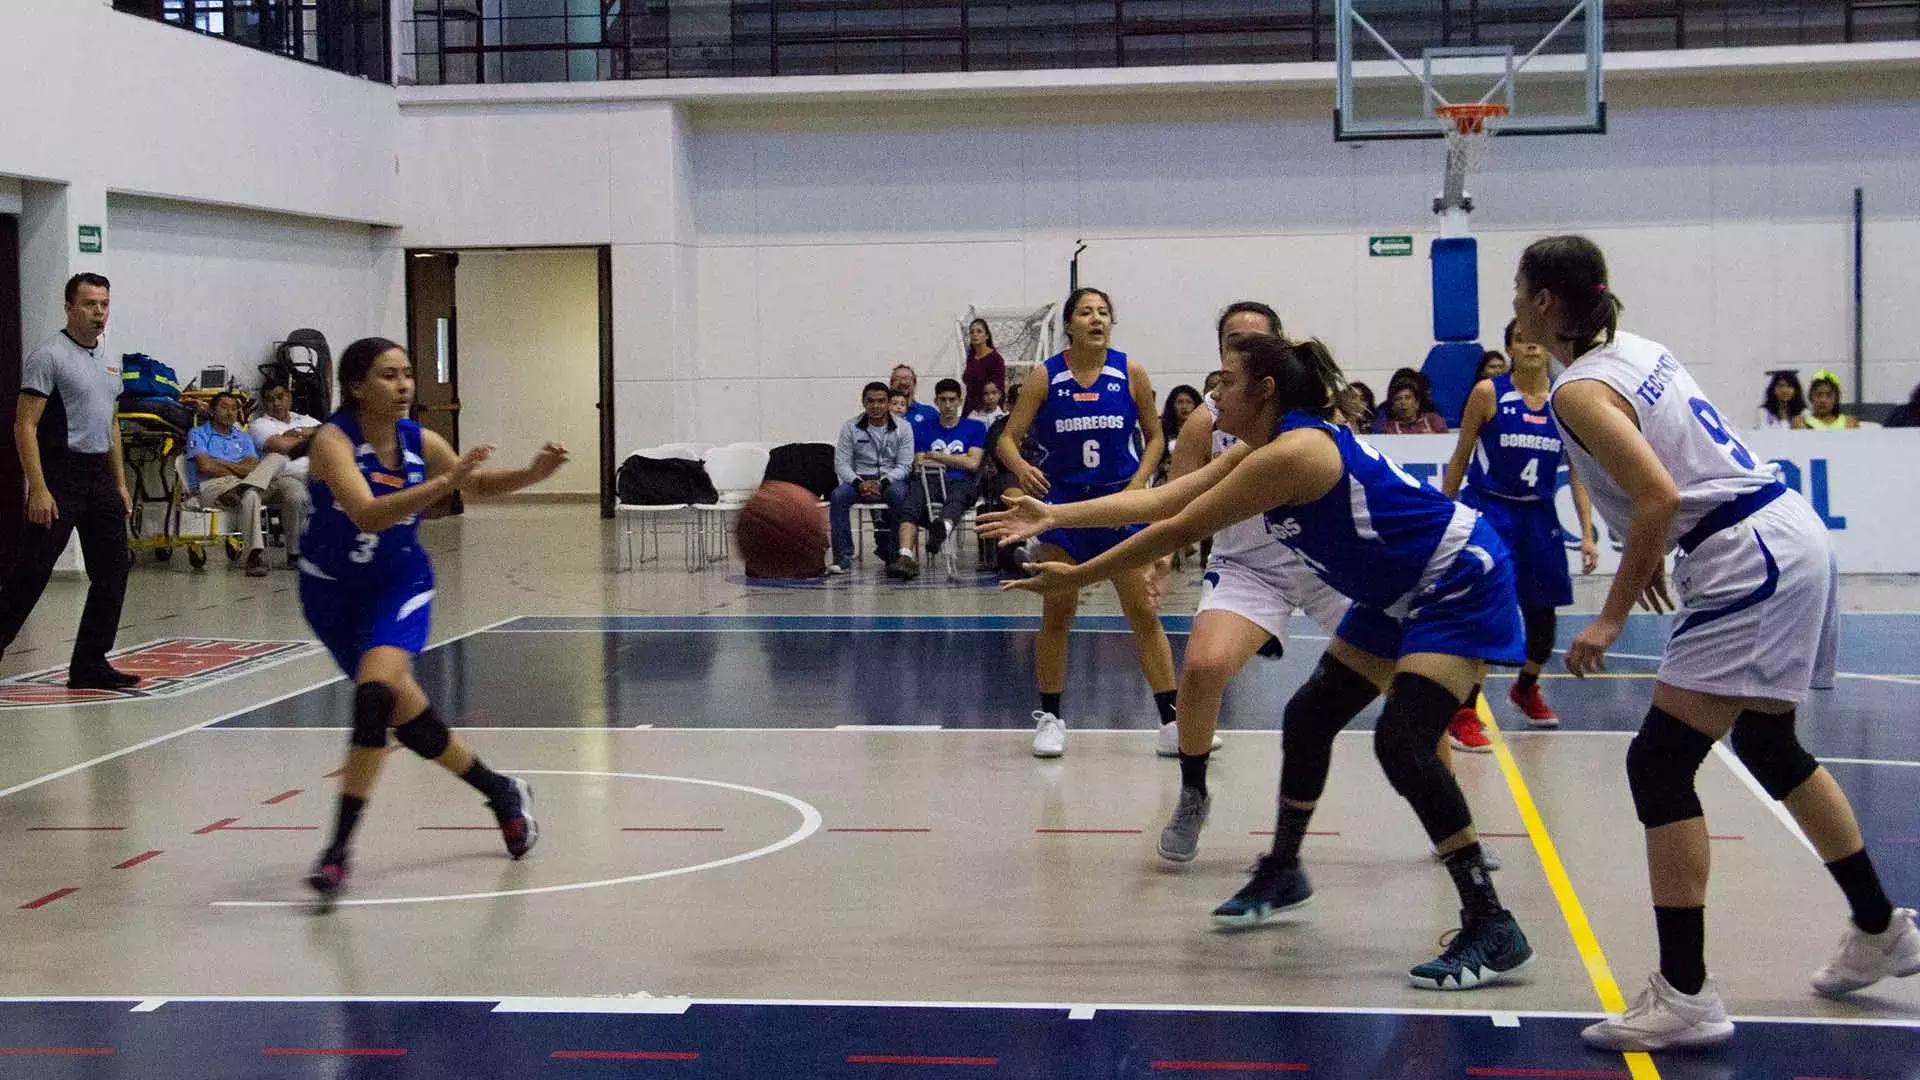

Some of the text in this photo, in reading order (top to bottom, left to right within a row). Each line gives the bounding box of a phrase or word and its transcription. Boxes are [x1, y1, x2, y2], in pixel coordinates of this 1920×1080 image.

[1055, 415, 1124, 433] BORREGOS
[1688, 396, 1755, 471] 9
[1082, 439, 1100, 468] 6
[1520, 458, 1538, 488] 4
[348, 532, 380, 563] 3
